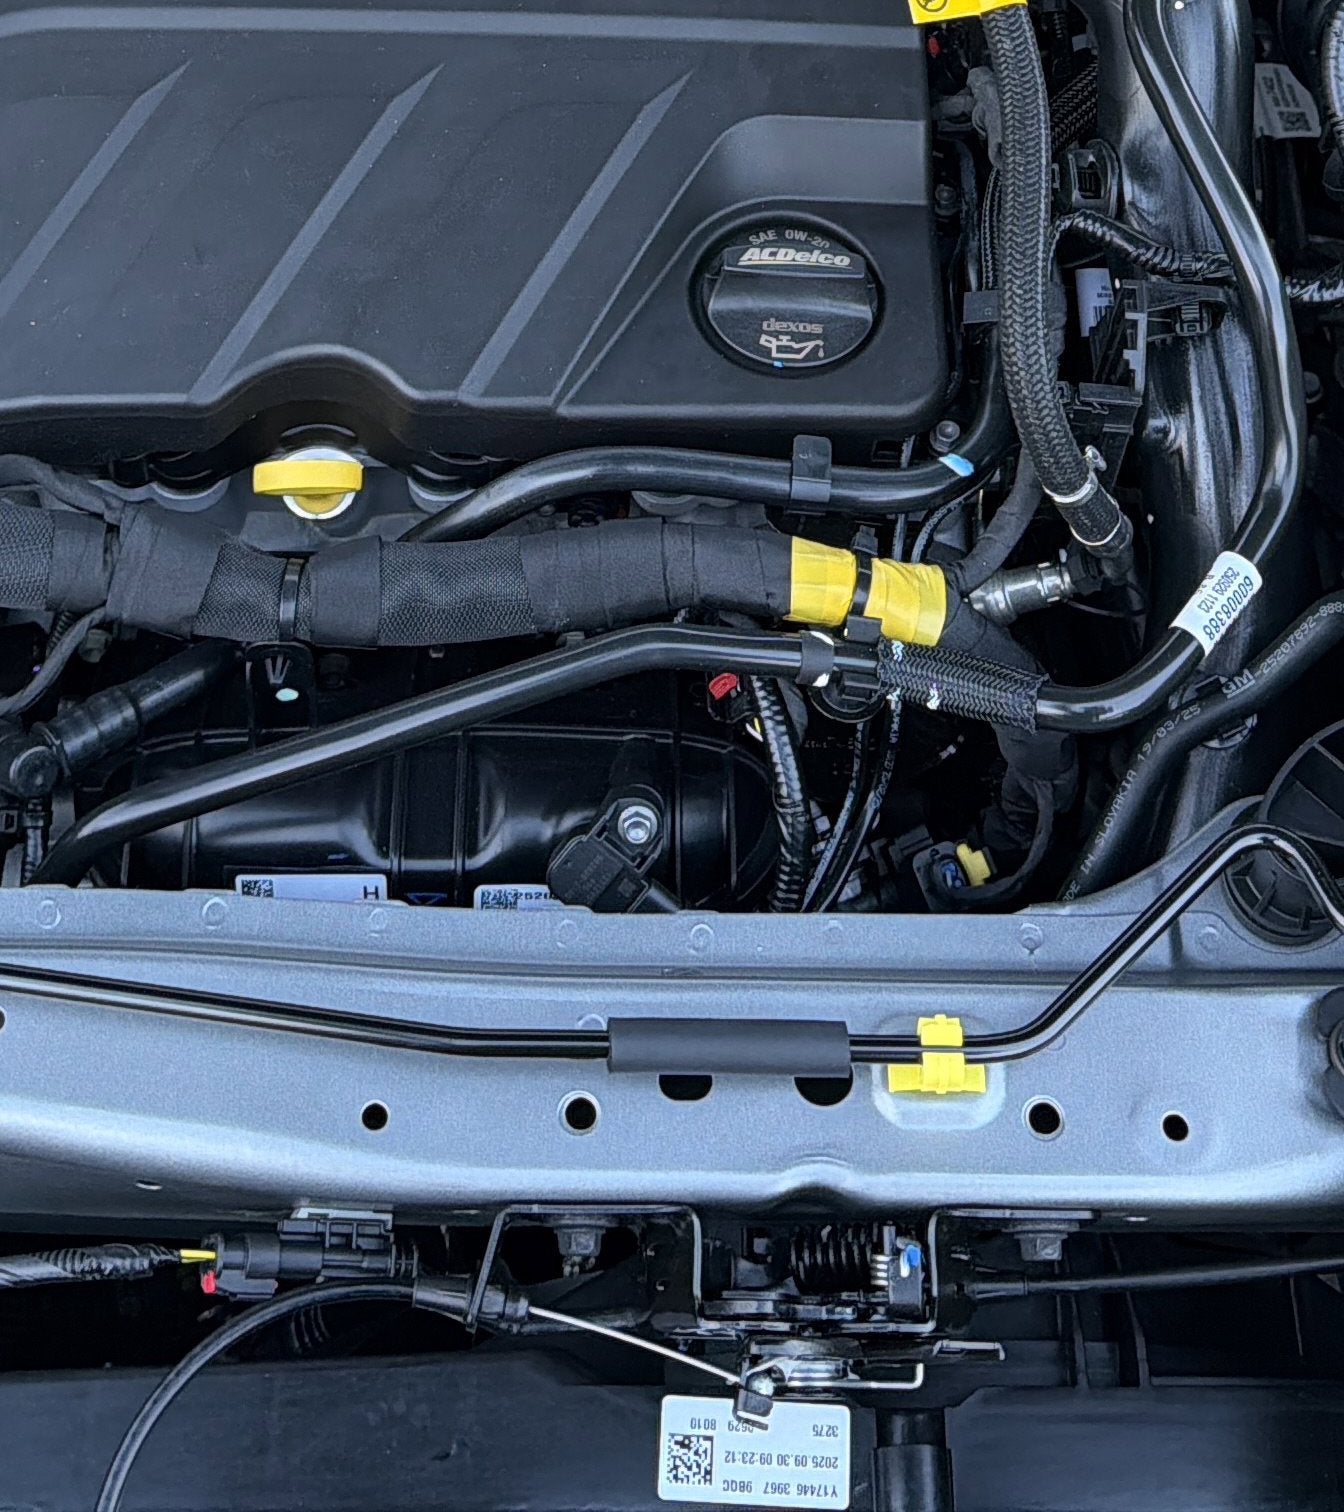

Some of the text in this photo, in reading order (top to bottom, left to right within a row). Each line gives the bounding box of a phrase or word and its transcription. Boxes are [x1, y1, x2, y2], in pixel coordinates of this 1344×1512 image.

[749, 229, 778, 246] SAE
[737, 247, 851, 267] ACDelco
[762, 318, 825, 333] dexos
[1202, 575, 1254, 641] 60008388
[1080, 854, 1097, 874] IN
[1094, 769, 1137, 849] SLOVAKIA
[1137, 704, 1202, 762] 19/03/25
[690, 1417, 716, 1430] 8010
[812, 1424, 839, 1437] 3275
[724, 1450, 839, 1469] 2025.09.30 09:23:12
[763, 1481, 791, 1495] 3967
[796, 1483, 838, 1498] Y17446
